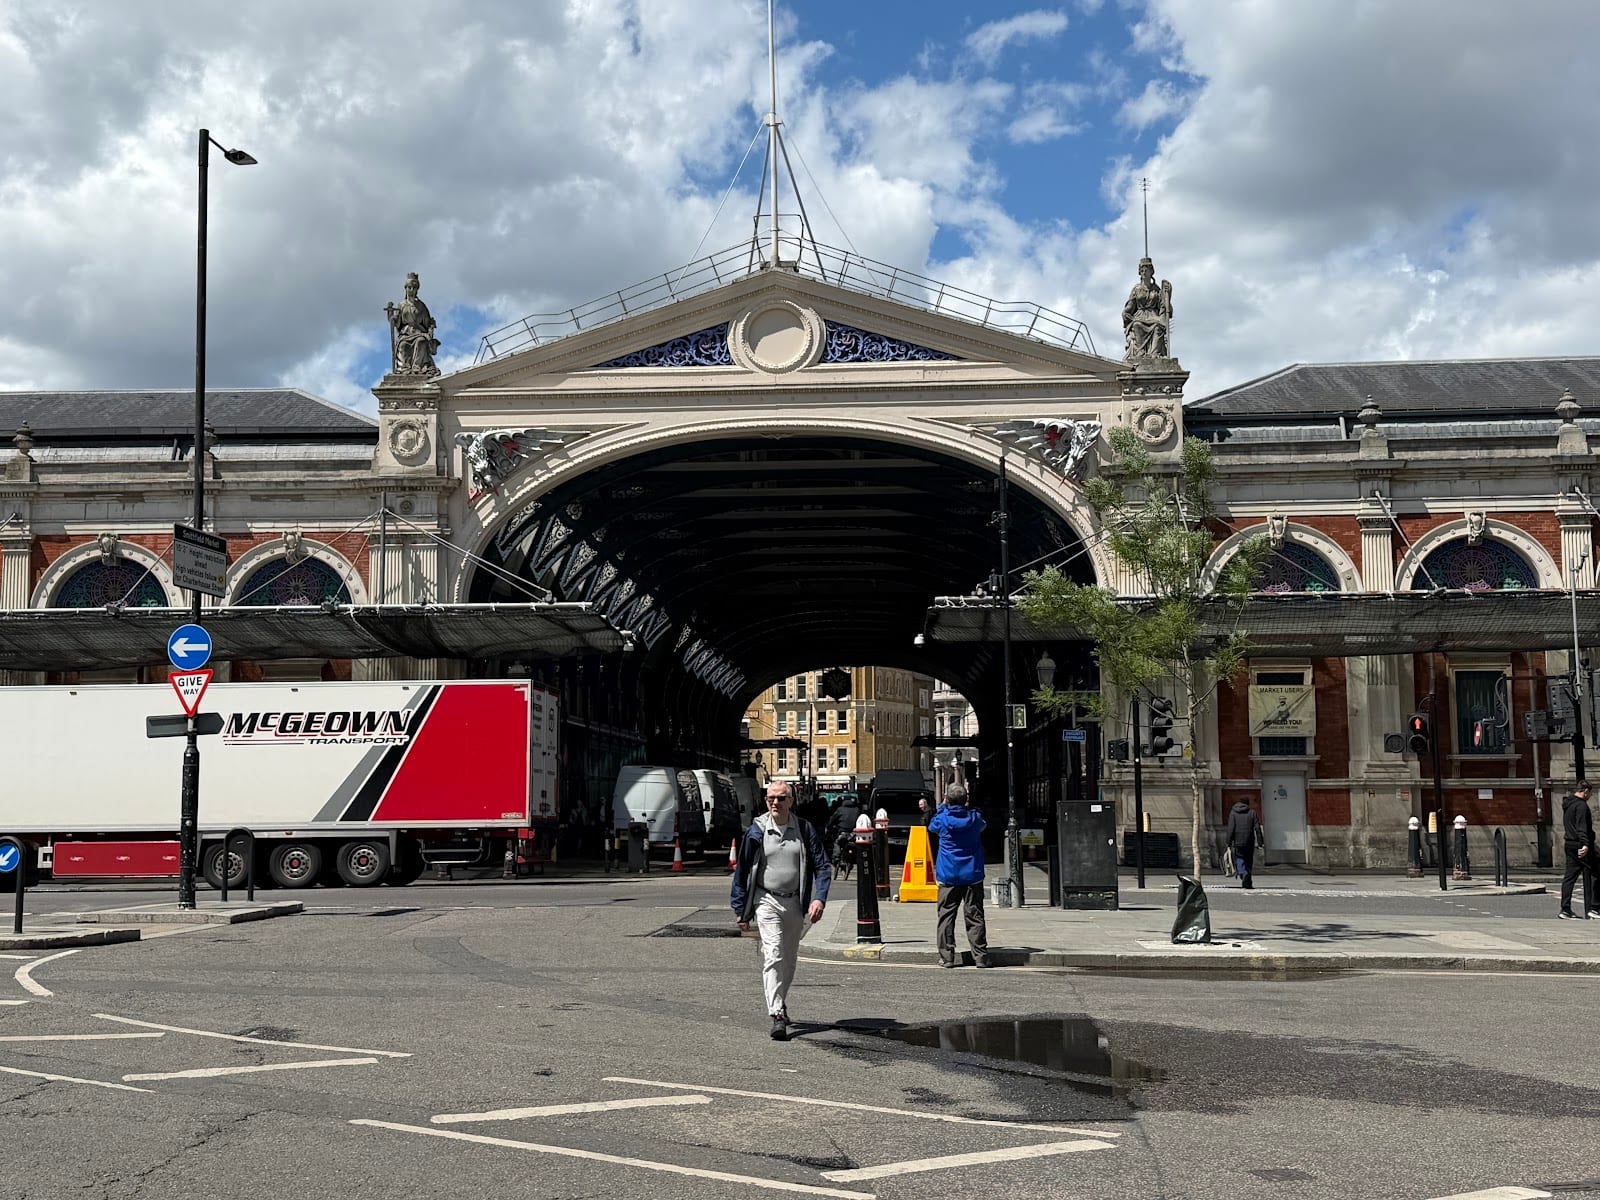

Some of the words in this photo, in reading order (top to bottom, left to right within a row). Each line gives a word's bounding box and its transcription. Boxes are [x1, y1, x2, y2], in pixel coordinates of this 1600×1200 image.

[182, 529, 205, 544] Smithfield
[205, 537, 220, 548] Market
[204, 552, 225, 564] restriction
[194, 560, 208, 570] ahead
[176, 562, 186, 574] High
[187, 567, 204, 578] vehicles
[204, 572, 217, 582] follow
[182, 574, 211, 588] Charterhouse
[178, 676, 203, 687] GIVE
